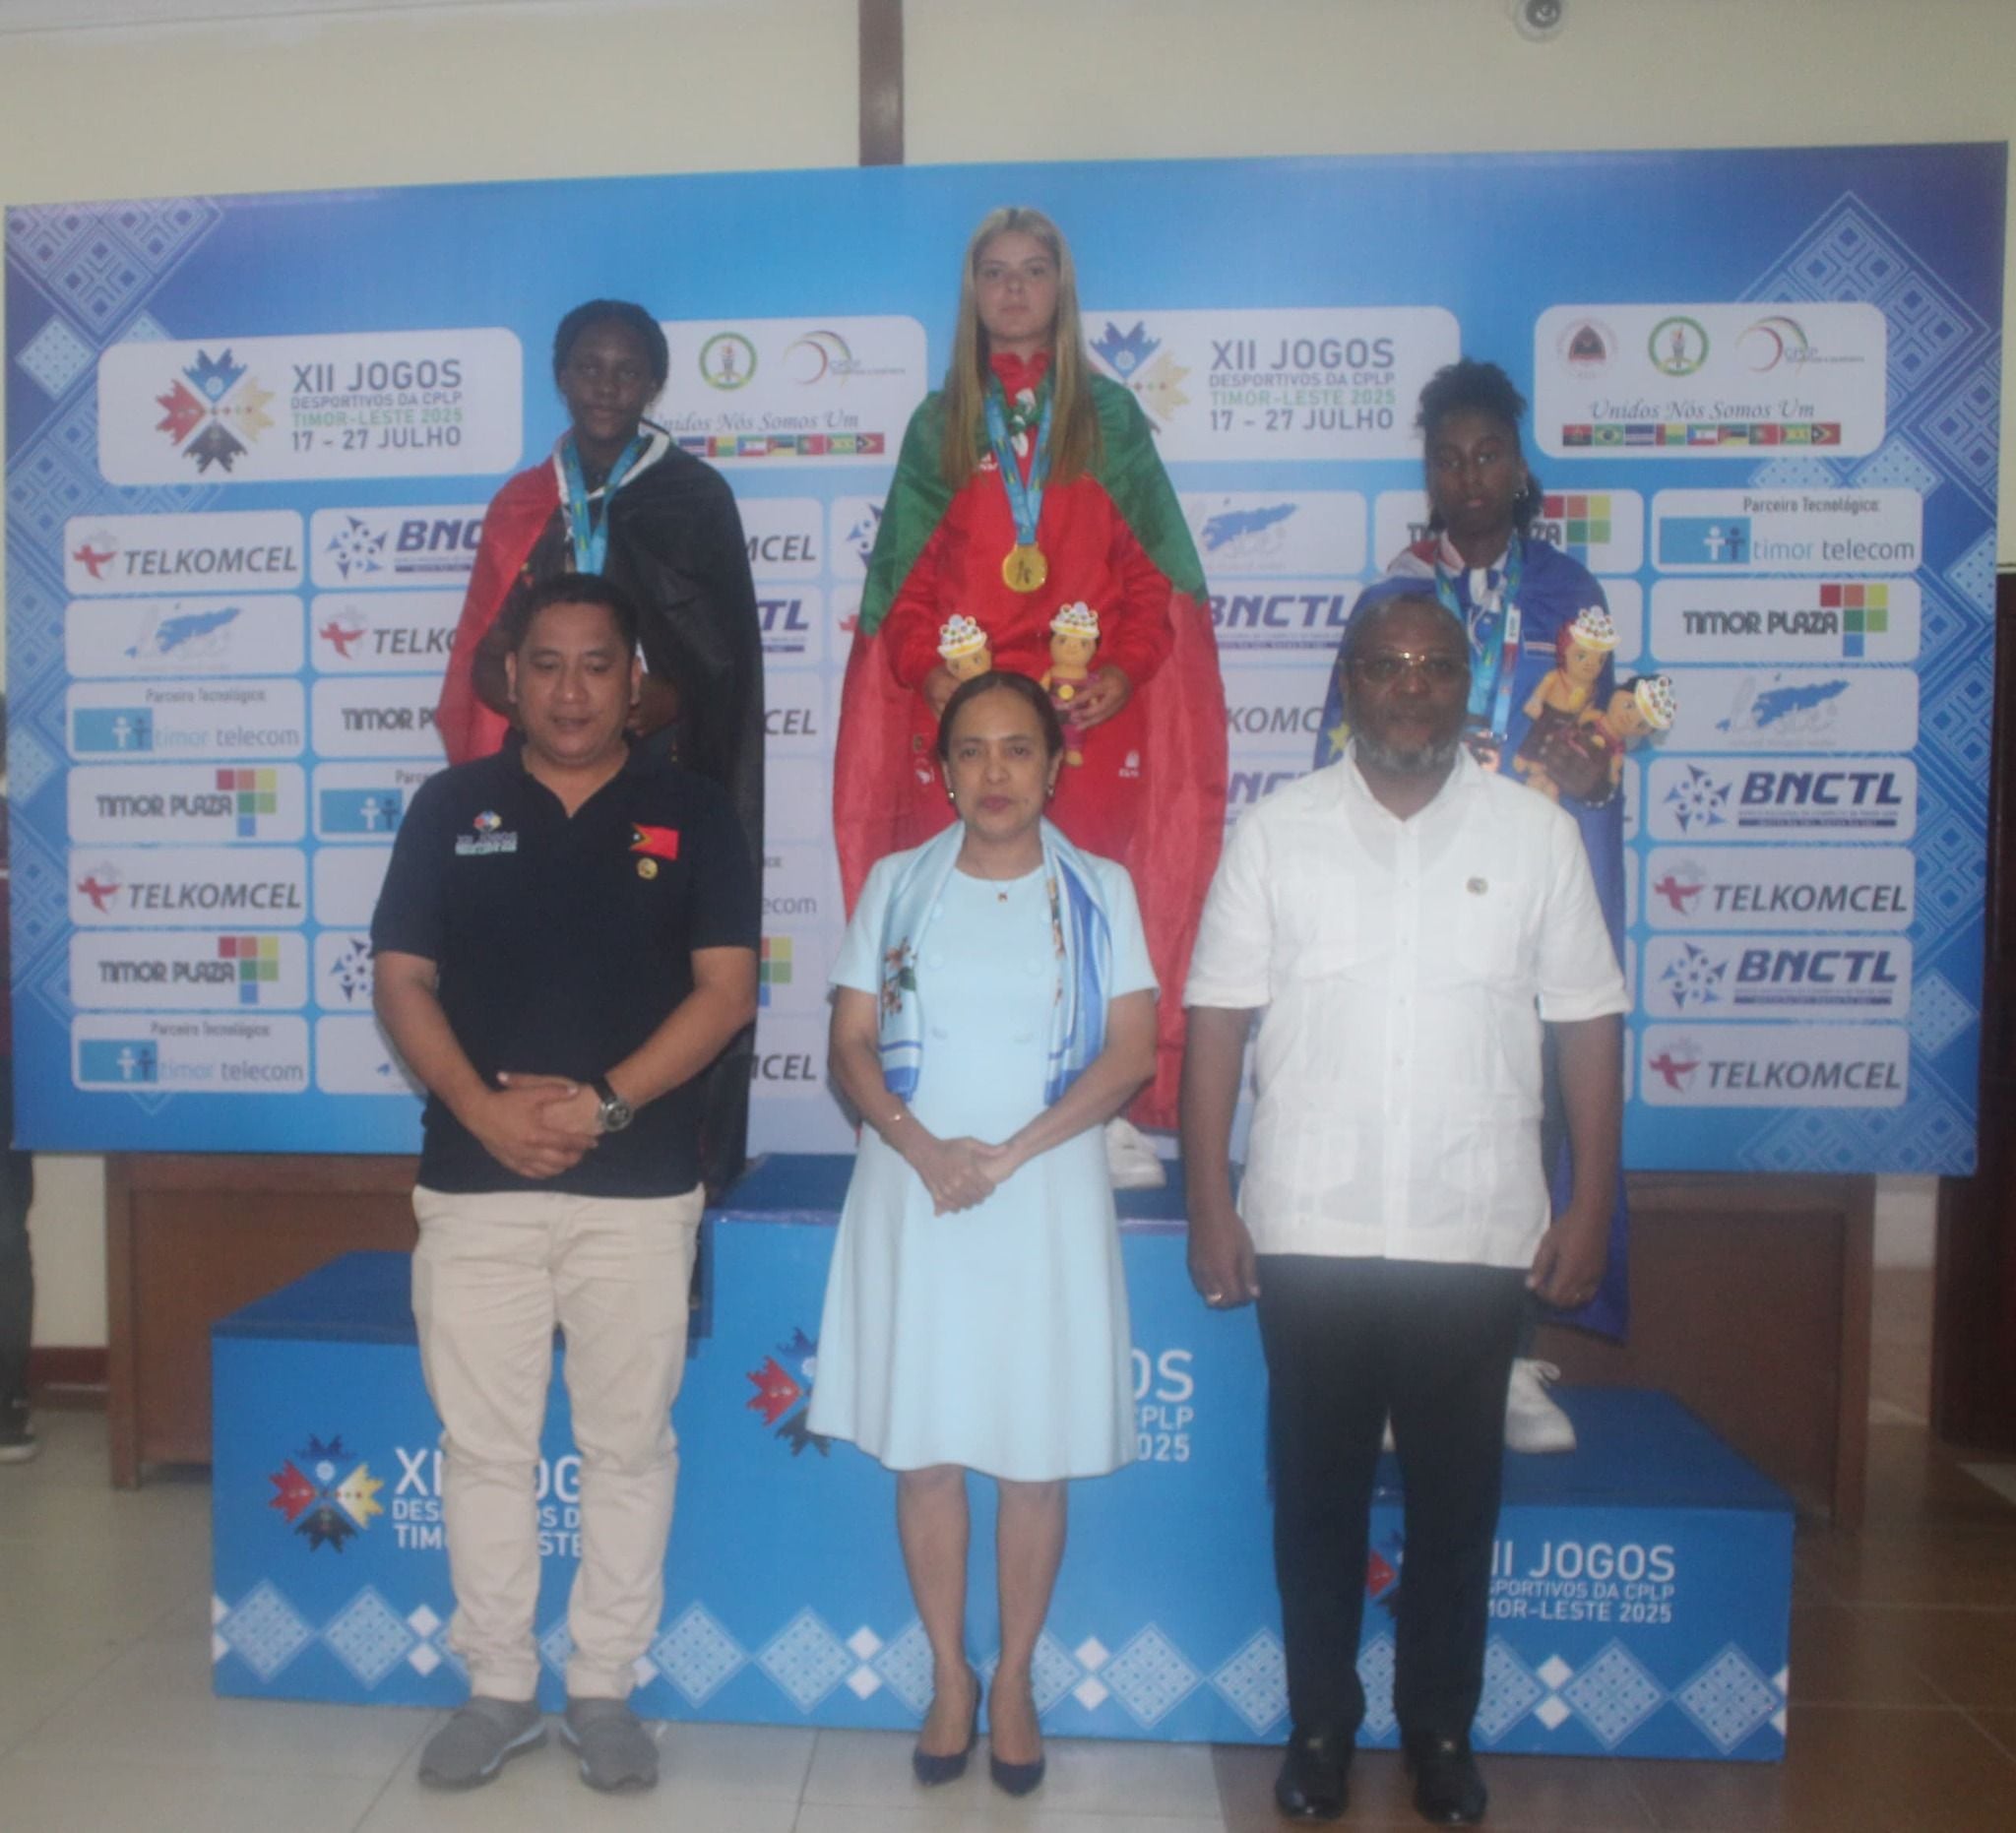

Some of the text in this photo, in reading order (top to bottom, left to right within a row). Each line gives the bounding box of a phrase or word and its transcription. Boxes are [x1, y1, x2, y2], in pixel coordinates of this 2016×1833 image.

[1211, 338, 1396, 370] XII JOGOS
[292, 359, 463, 393] XII JOGOS
[1209, 372, 1396, 388] DESPORTIVOS DA CPLP
[291, 391, 463, 411] DESPORTIVOS DA CPLP
[1211, 391, 1347, 408] TIMOR-LESTE
[1588, 400, 1661, 420] Unidos
[1713, 400, 1772, 420] Somos
[292, 409, 415, 428] TIMOR-LESTE
[1210, 410, 1234, 432] 17
[1265, 410, 1295, 431] 27
[1303, 408, 1395, 431] JULHO
[291, 430, 313, 453] 17
[342, 428, 369, 451] 27
[378, 426, 463, 449] JULHO
[397, 519, 482, 551] BNC
[124, 546, 298, 575] TELKOMCEL
[1752, 535, 1916, 561] timor telecom
[1683, 610, 1838, 635] TIMOR PLAZA
[341, 706, 414, 731] TIMOR
[156, 727, 300, 747] timor telecom
[1740, 772, 1903, 804] BNCTL
[95, 792, 233, 817] TIMOR PLAZA
[128, 882, 302, 910] TELKOMCEL
[1713, 884, 1908, 913] TELKOMCEL
[97, 960, 235, 984] TIMOR PLAZA
[1735, 949, 1898, 983] BNCTL
[159, 1060, 303, 1082] timor telecom
[1708, 1060, 1902, 1090] TELKOMCEL
[1140, 1406, 1195, 1430] PLP
[1137, 1432, 1191, 1463] 025
[395, 1447, 444, 1497] XI
[1529, 1542, 1675, 1583] JOGOS
[1593, 1581, 1620, 1600] DA
[1625, 1583, 1675, 1602] CPLP
[1619, 1603, 1672, 1623] 2025
